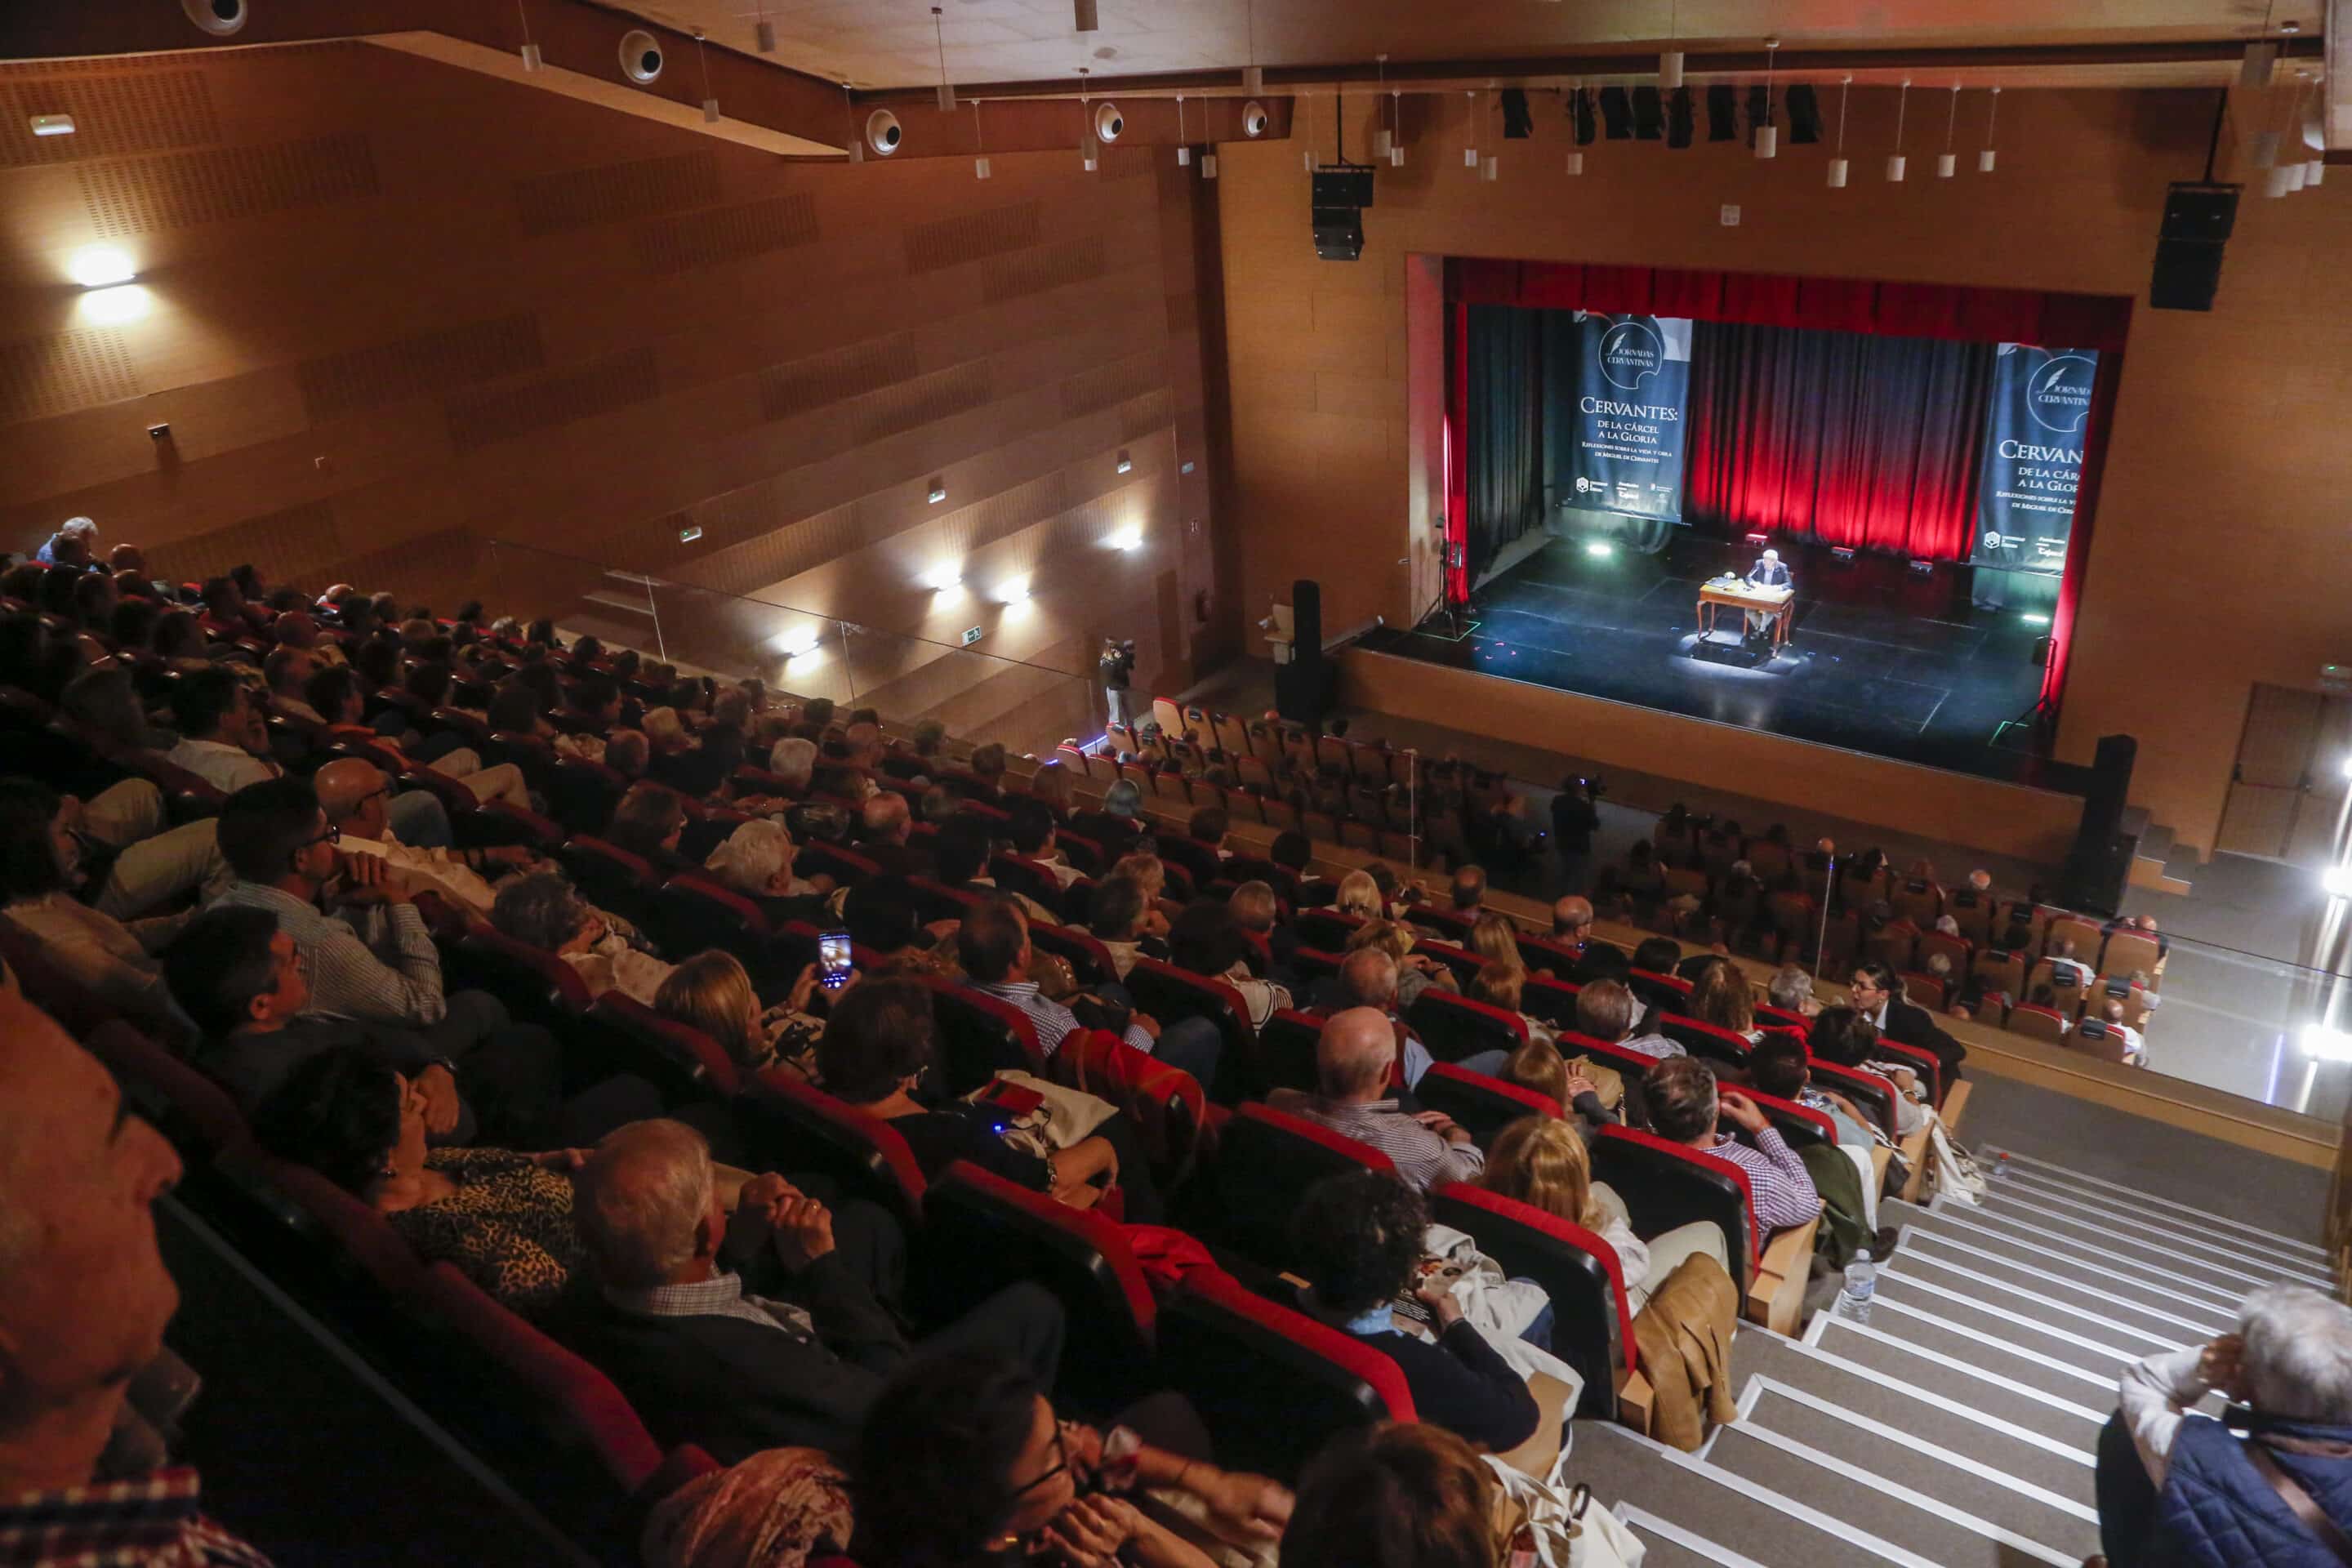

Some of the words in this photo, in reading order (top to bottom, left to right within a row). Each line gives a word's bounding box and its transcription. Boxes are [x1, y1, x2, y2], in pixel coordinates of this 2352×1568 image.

[1618, 348, 1654, 358] JORNADAS
[1607, 358, 1653, 367] CERVANTINAS
[1581, 396, 1678, 421] CERVANTES:
[1597, 420, 1609, 428] DE
[1611, 421, 1622, 430] LA
[1624, 422, 1659, 434] CÁRCEL
[1598, 430, 1605, 439] A
[1607, 432, 1619, 440] LA
[1620, 432, 1657, 444] GLORIA
[1998, 439, 2083, 464] CERVAN
[2018, 466, 2034, 476] DE
[2035, 468, 2050, 478] LA
[2018, 479, 2026, 487] A
[2029, 480, 2044, 489] LA
